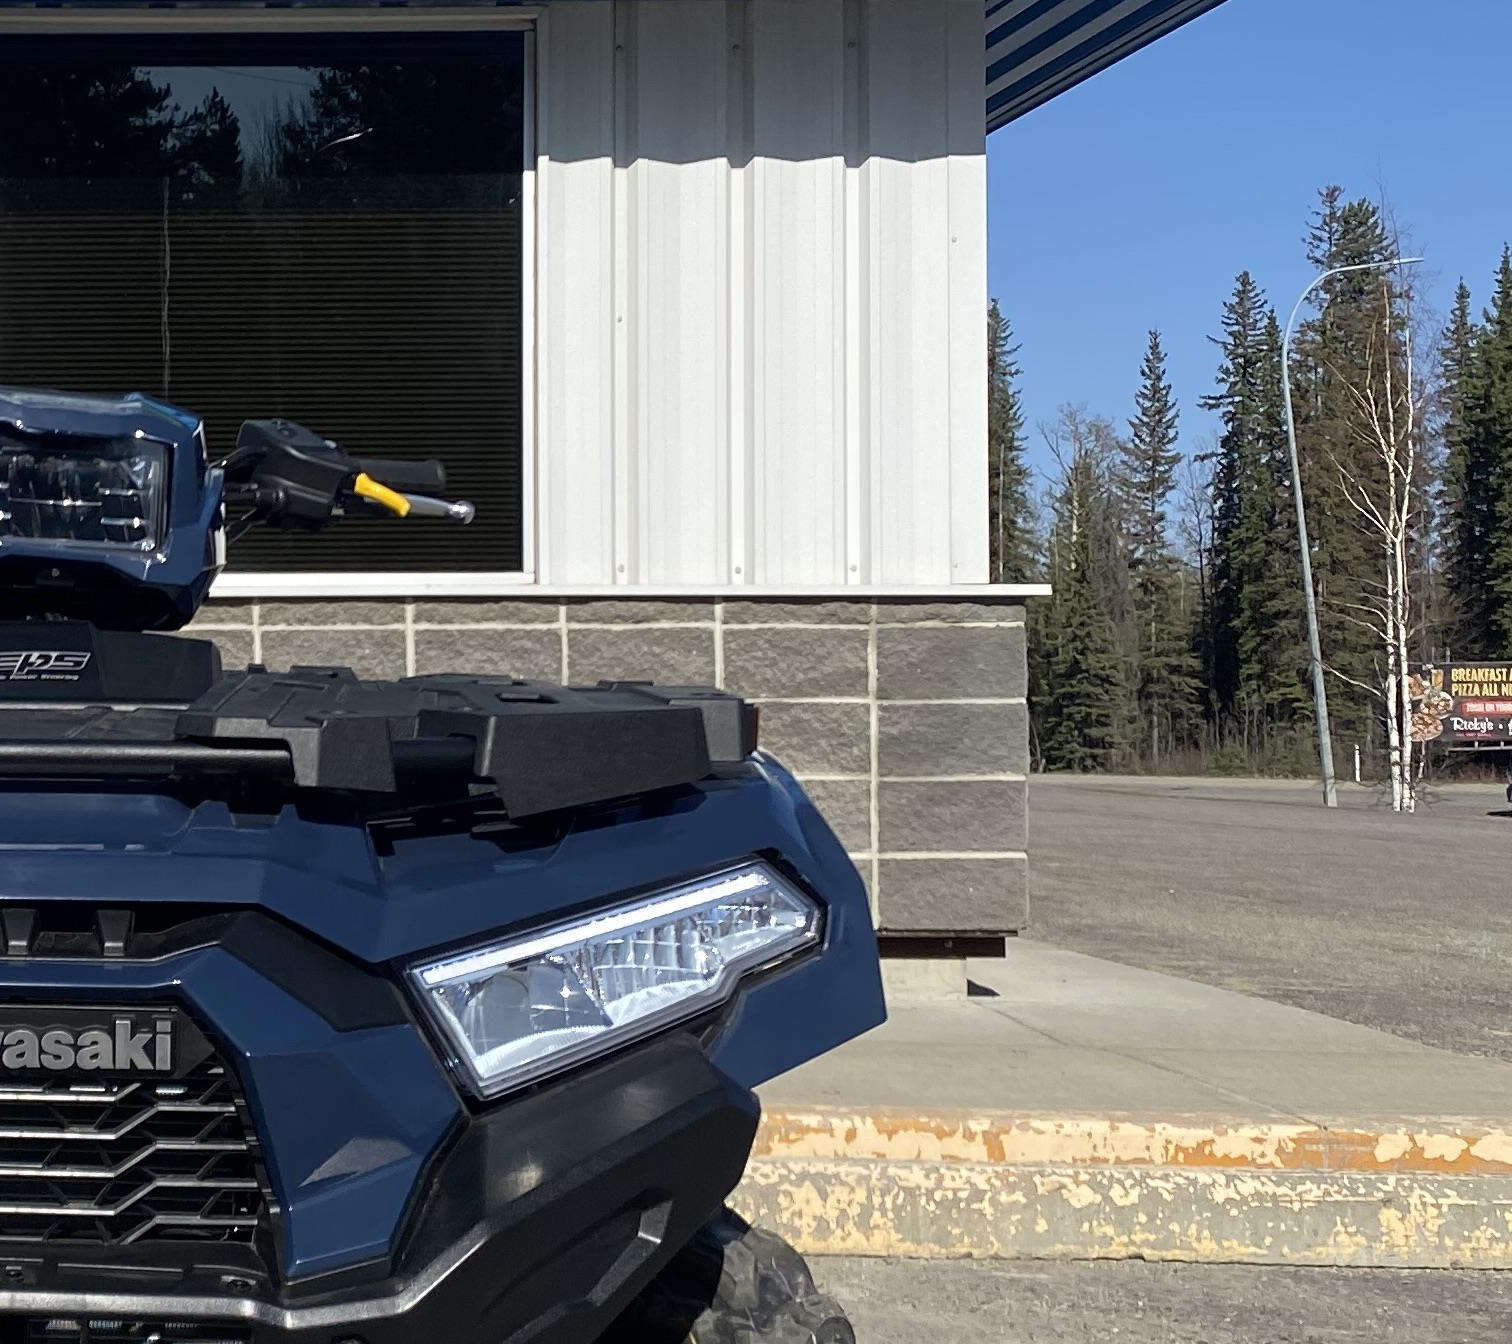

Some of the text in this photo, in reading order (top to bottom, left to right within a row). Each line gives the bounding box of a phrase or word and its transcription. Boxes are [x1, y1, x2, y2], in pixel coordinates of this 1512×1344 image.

[1451, 668, 1508, 682] BREAKFAST
[1451, 683, 1481, 697] PIZZA
[1481, 683, 1500, 697] ALL
[1450, 717, 1494, 734] Ricky's
